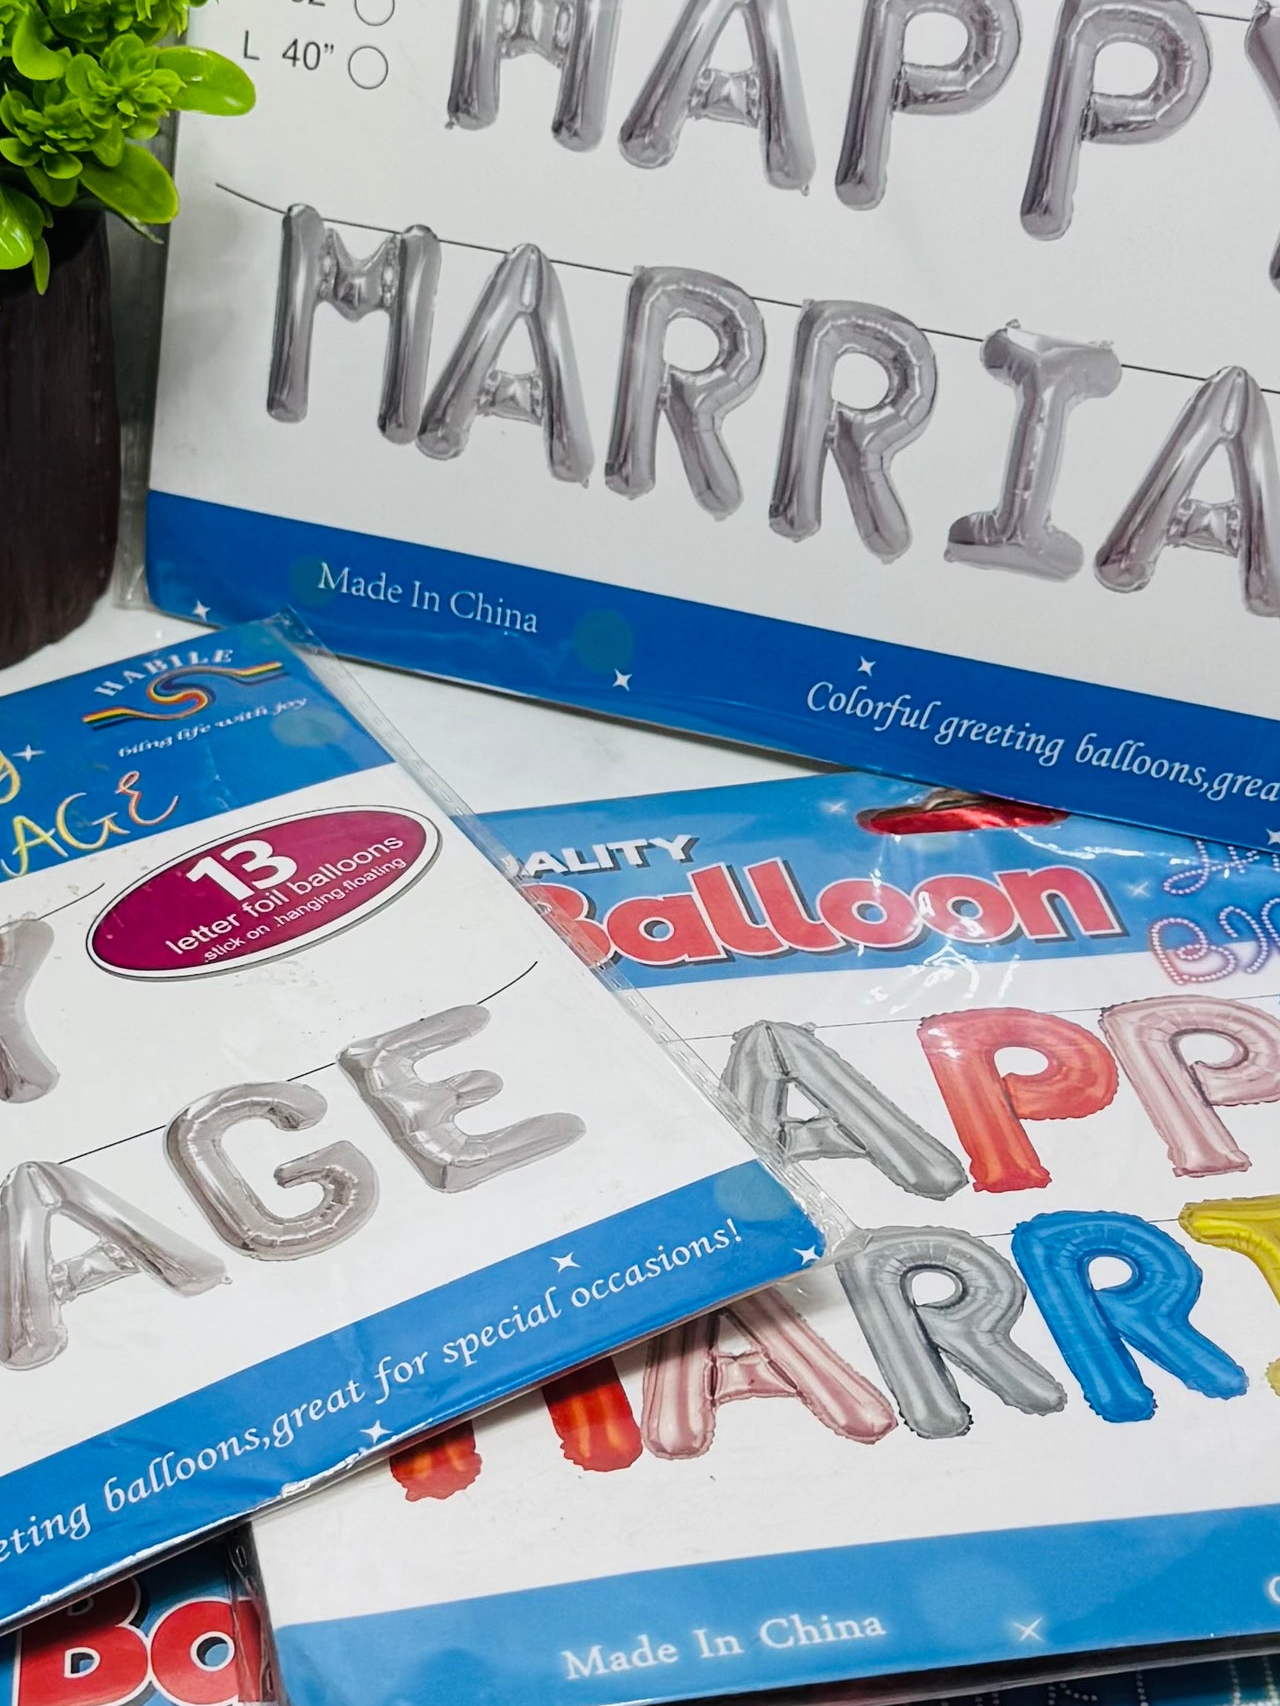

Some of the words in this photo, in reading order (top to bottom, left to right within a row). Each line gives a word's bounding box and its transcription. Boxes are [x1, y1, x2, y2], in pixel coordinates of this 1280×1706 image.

[243, 30, 260, 60] L
[318, 562, 403, 604] Made
[411, 580, 440, 612] In
[450, 591, 538, 633] China
[94, 649, 233, 698] HABILE
[214, 705, 269, 728] with
[272, 697, 308, 716] joy
[806, 681, 940, 731] Colorful
[934, 715, 1065, 767] greeting
[165, 912, 237, 955] letter
[242, 887, 285, 918] foil
[289, 836, 404, 896] balloons
[186, 839, 298, 901] 13
[246, 924, 271, 941] on
[373, 1350, 429, 1404] for
[443, 1285, 562, 1367] special
[570, 1217, 742, 1309] occasions!
[561, 1634, 678, 1680] Made
[693, 1629, 744, 1658] In
[759, 1613, 886, 1648] China
